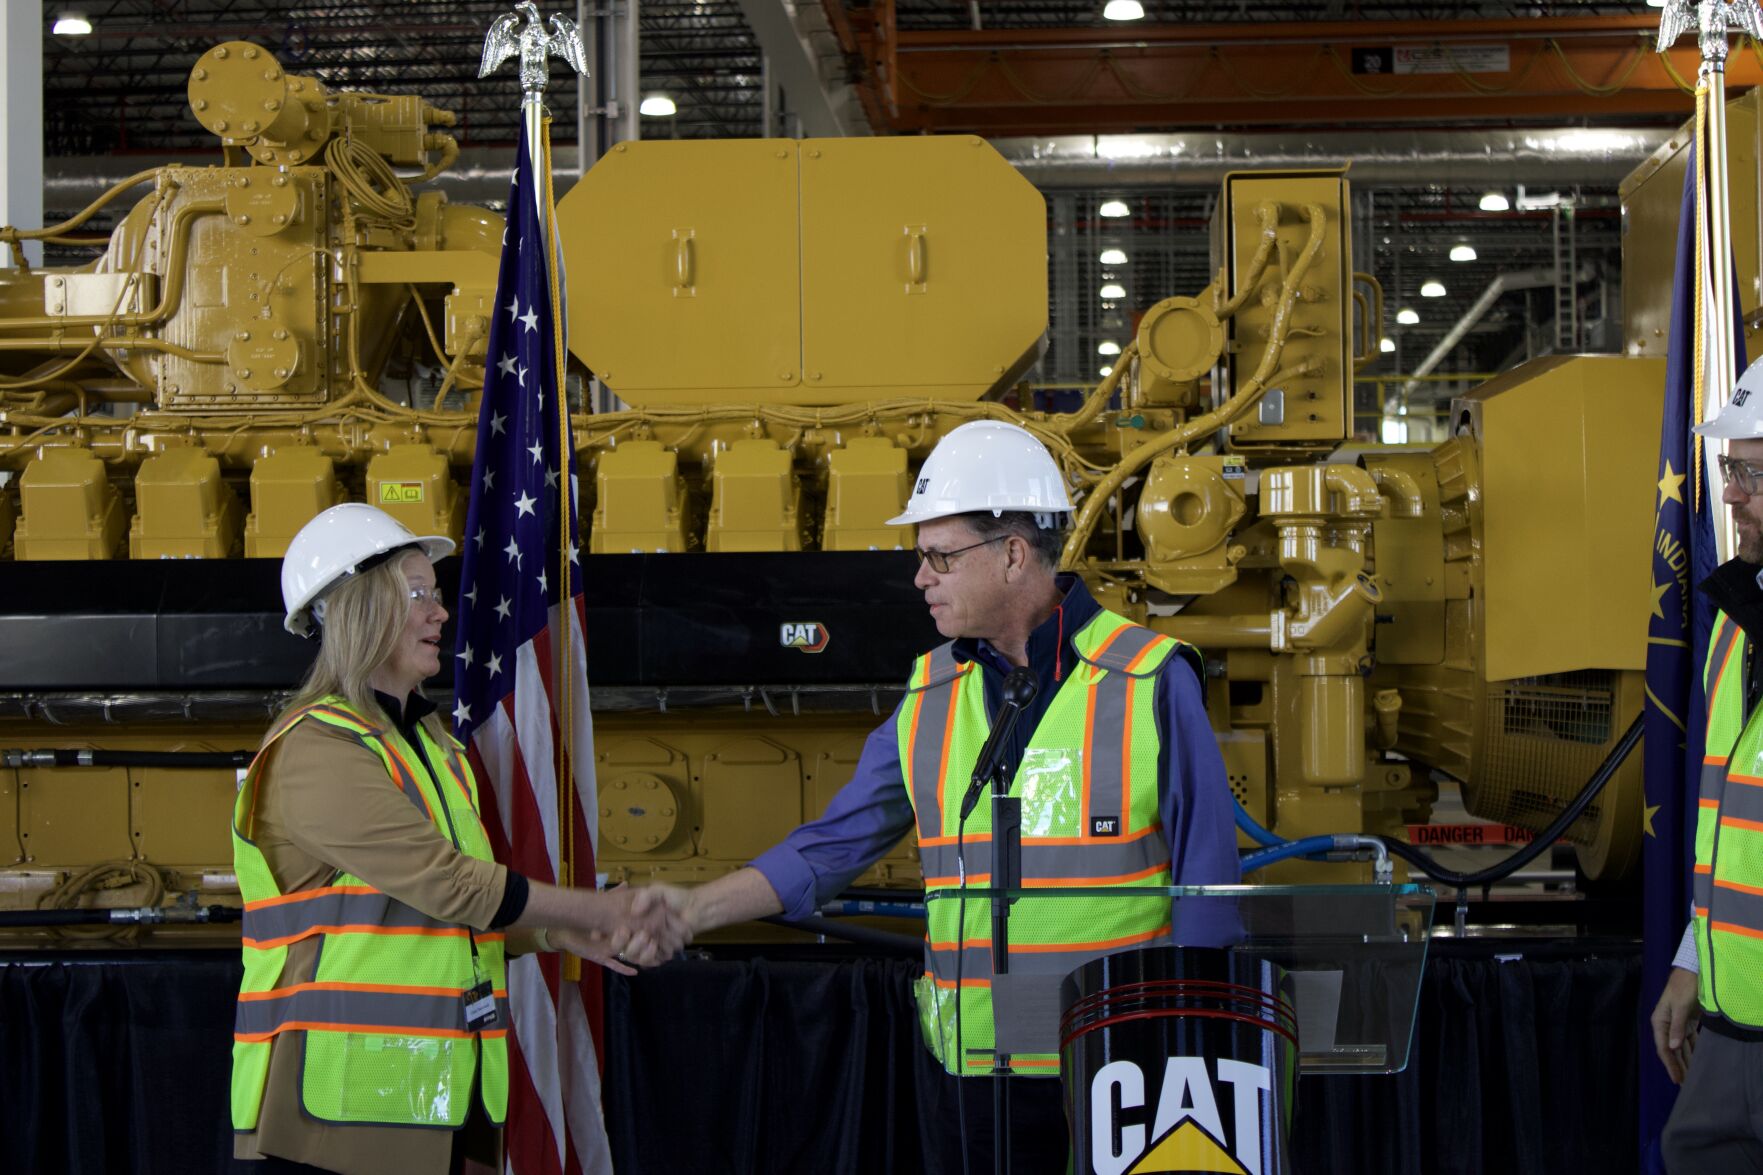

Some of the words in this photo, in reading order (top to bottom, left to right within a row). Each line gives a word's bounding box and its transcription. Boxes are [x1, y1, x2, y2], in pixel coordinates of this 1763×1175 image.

[1732, 388, 1752, 407] CAT
[916, 478, 930, 494] CAT
[782, 624, 817, 646] CAT
[1095, 820, 1114, 833] CAT
[1418, 826, 1483, 842] DANGER
[1504, 826, 1536, 841] DAN
[1091, 1056, 1270, 1175] CAT
